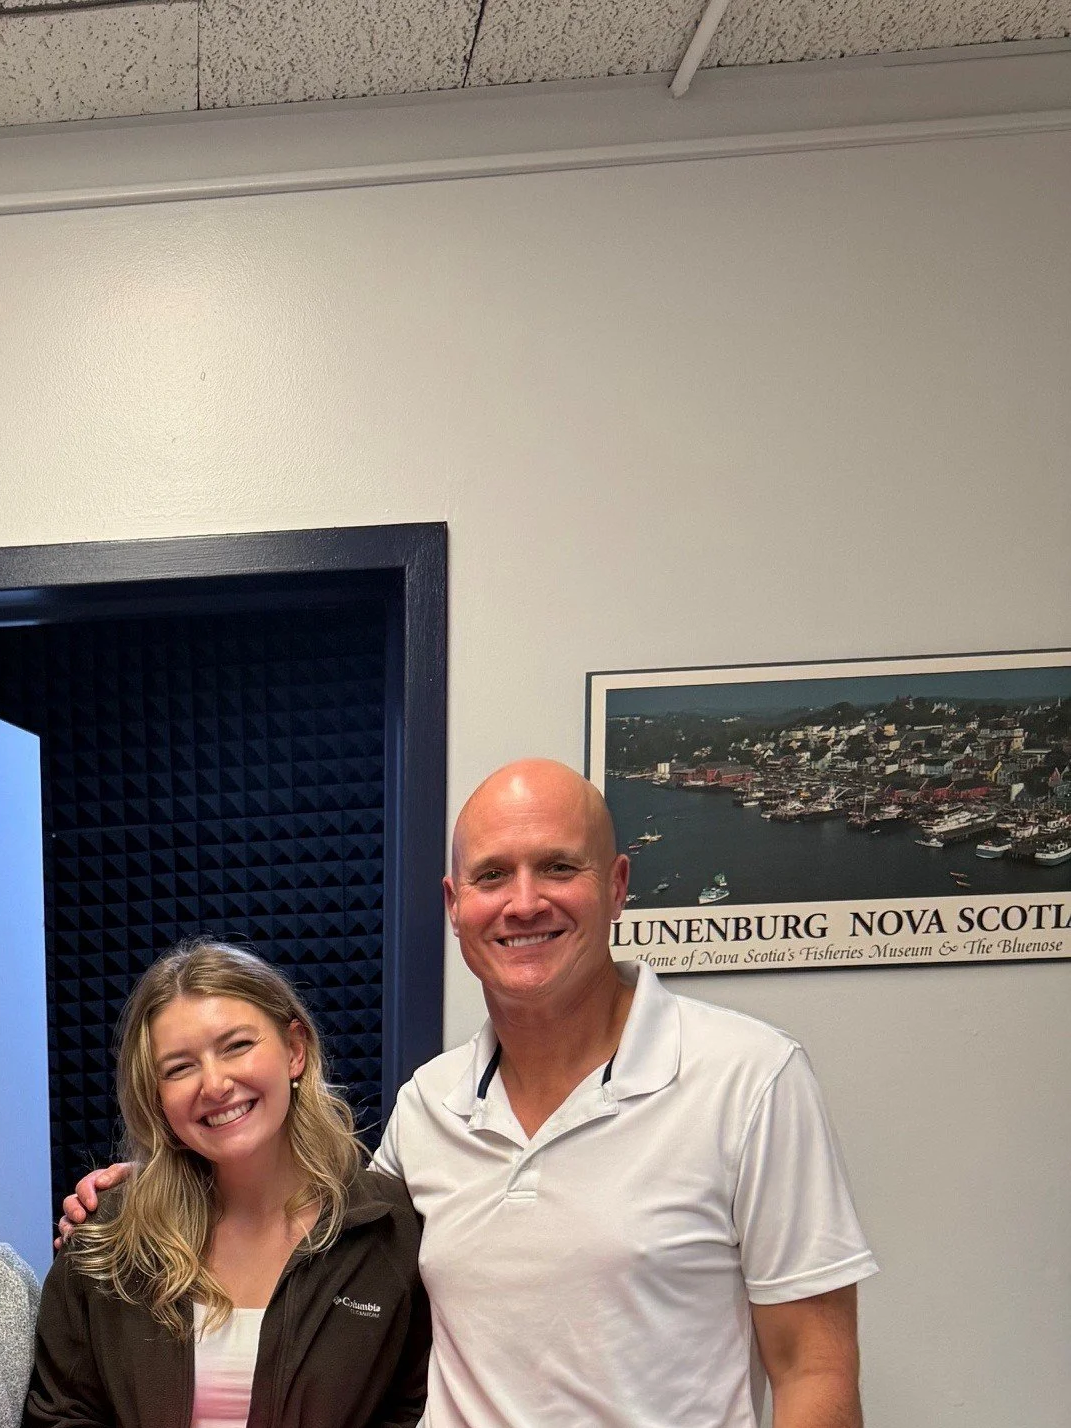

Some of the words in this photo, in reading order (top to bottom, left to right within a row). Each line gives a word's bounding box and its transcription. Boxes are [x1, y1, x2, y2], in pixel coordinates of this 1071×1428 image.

[611, 912, 828, 947] LUNENBURG
[849, 908, 947, 937] NOVA
[681, 949, 697, 971] of
[698, 950, 739, 966] Nova
[743, 948, 795, 965] Scotia's
[799, 943, 864, 962] Fisheries
[868, 943, 933, 959] Museum
[938, 941, 959, 957] &
[963, 938, 993, 955] The
[997, 936, 1063, 954] Bluenose
